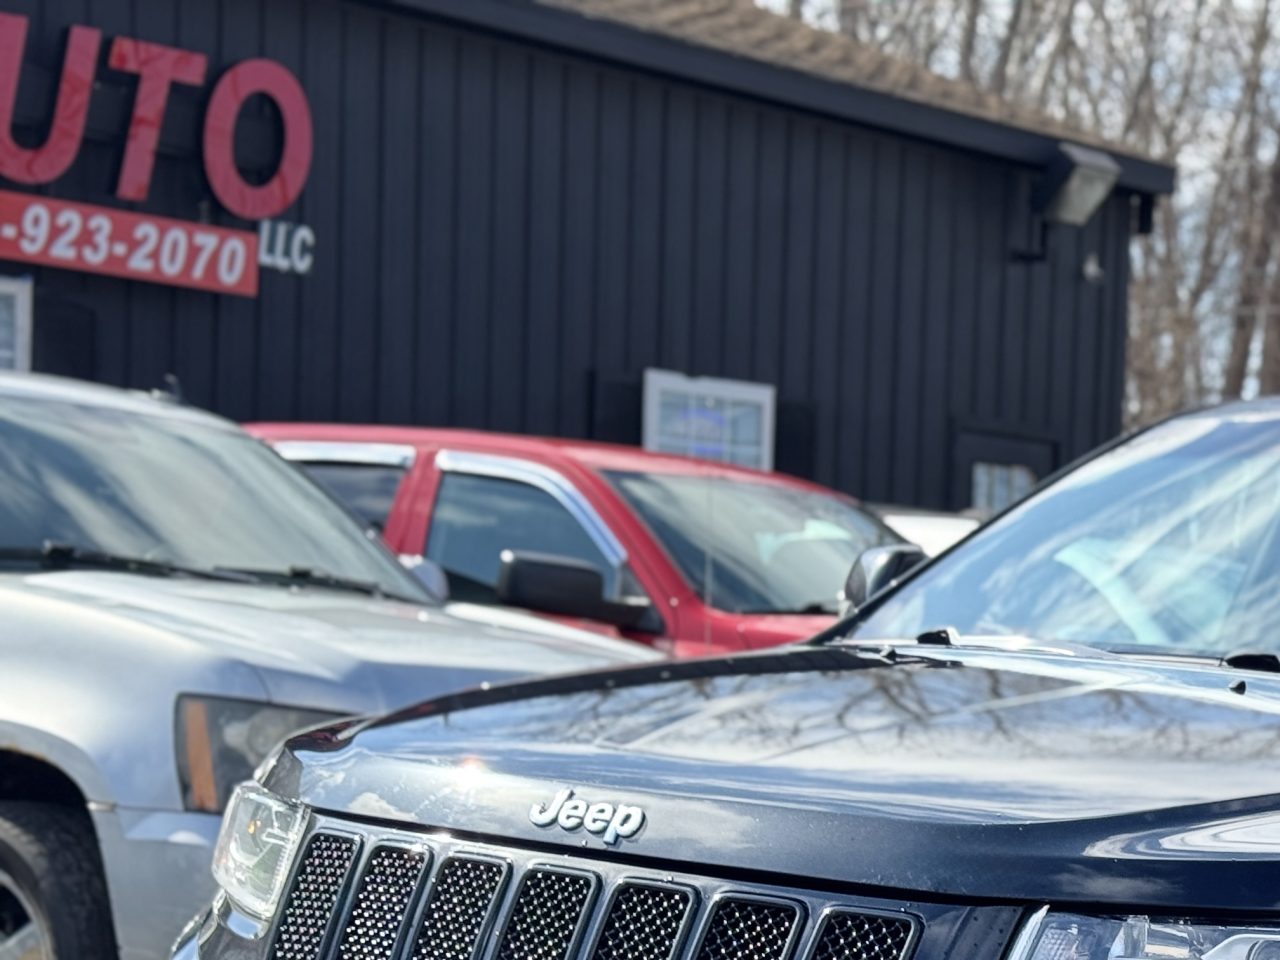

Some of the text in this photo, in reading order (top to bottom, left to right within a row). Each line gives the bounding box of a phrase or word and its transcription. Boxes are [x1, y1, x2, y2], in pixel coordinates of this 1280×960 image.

[0, 12, 313, 220] UTO
[259, 219, 315, 273] LLC
[529, 788, 647, 845] Jeep
